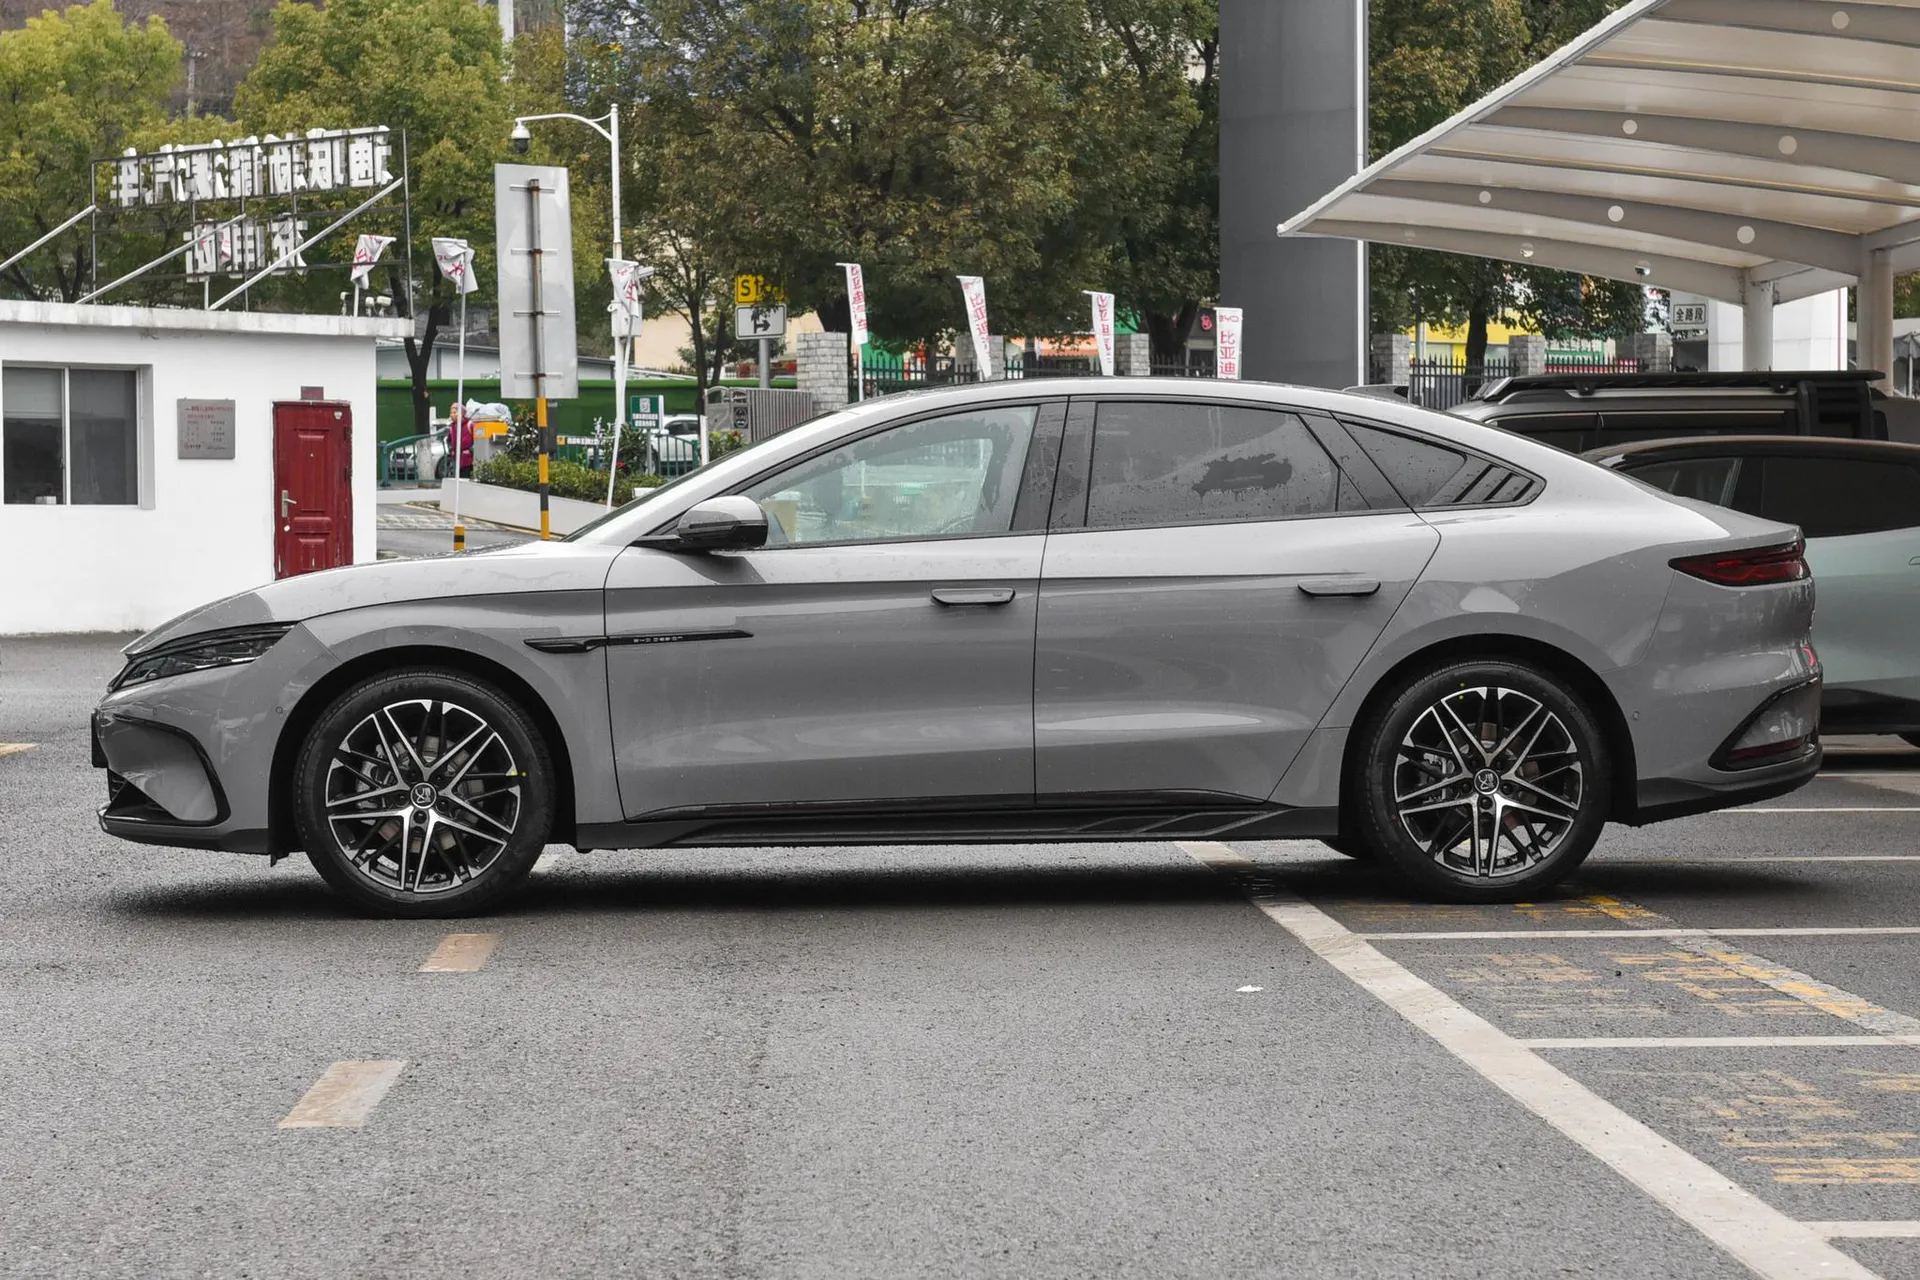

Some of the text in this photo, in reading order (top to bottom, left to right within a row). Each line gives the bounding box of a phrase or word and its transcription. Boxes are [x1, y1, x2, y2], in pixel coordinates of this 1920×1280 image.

[1676, 308, 1703, 321] 全路段
[1220, 331, 1236, 379] 比亚迪
